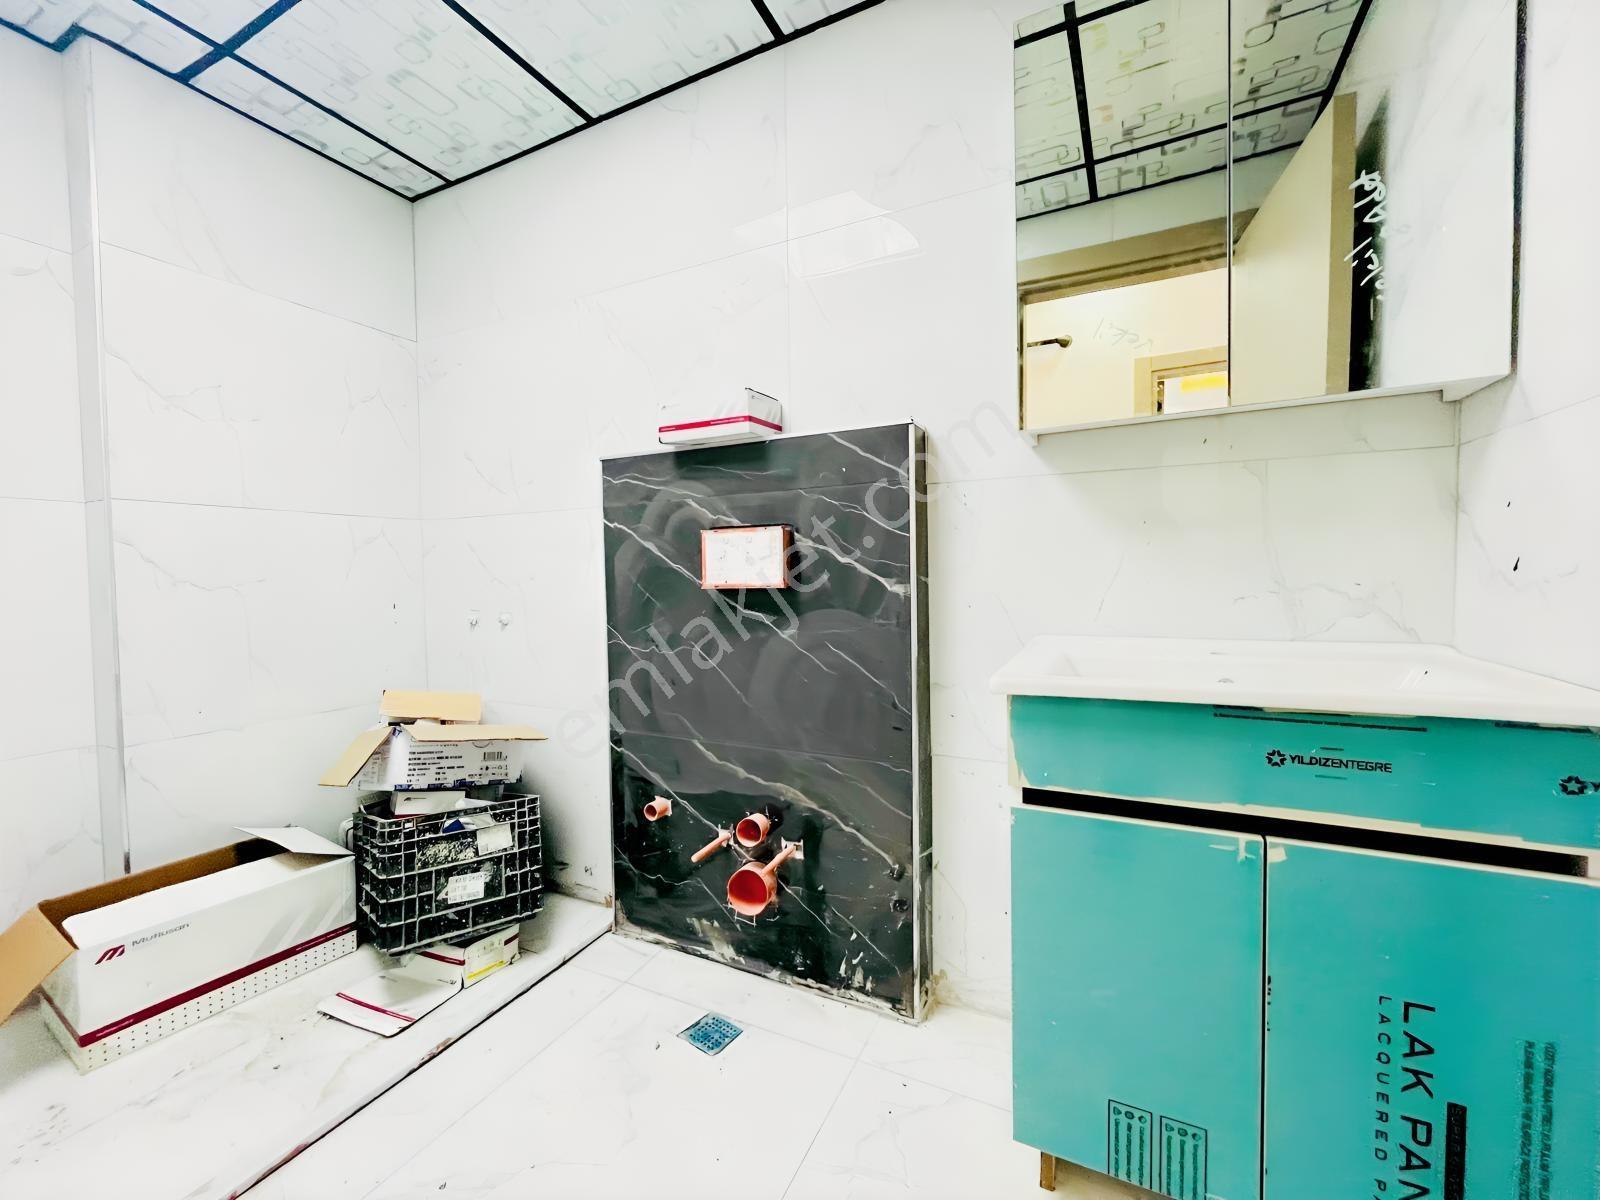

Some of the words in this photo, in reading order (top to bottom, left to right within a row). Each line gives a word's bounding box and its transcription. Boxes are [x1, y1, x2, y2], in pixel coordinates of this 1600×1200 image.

[1288, 753, 1393, 774] YILDIZENTEGRE
[1374, 995, 1393, 1162] LACQUERED
[1400, 1001, 1437, 1100] LAK
